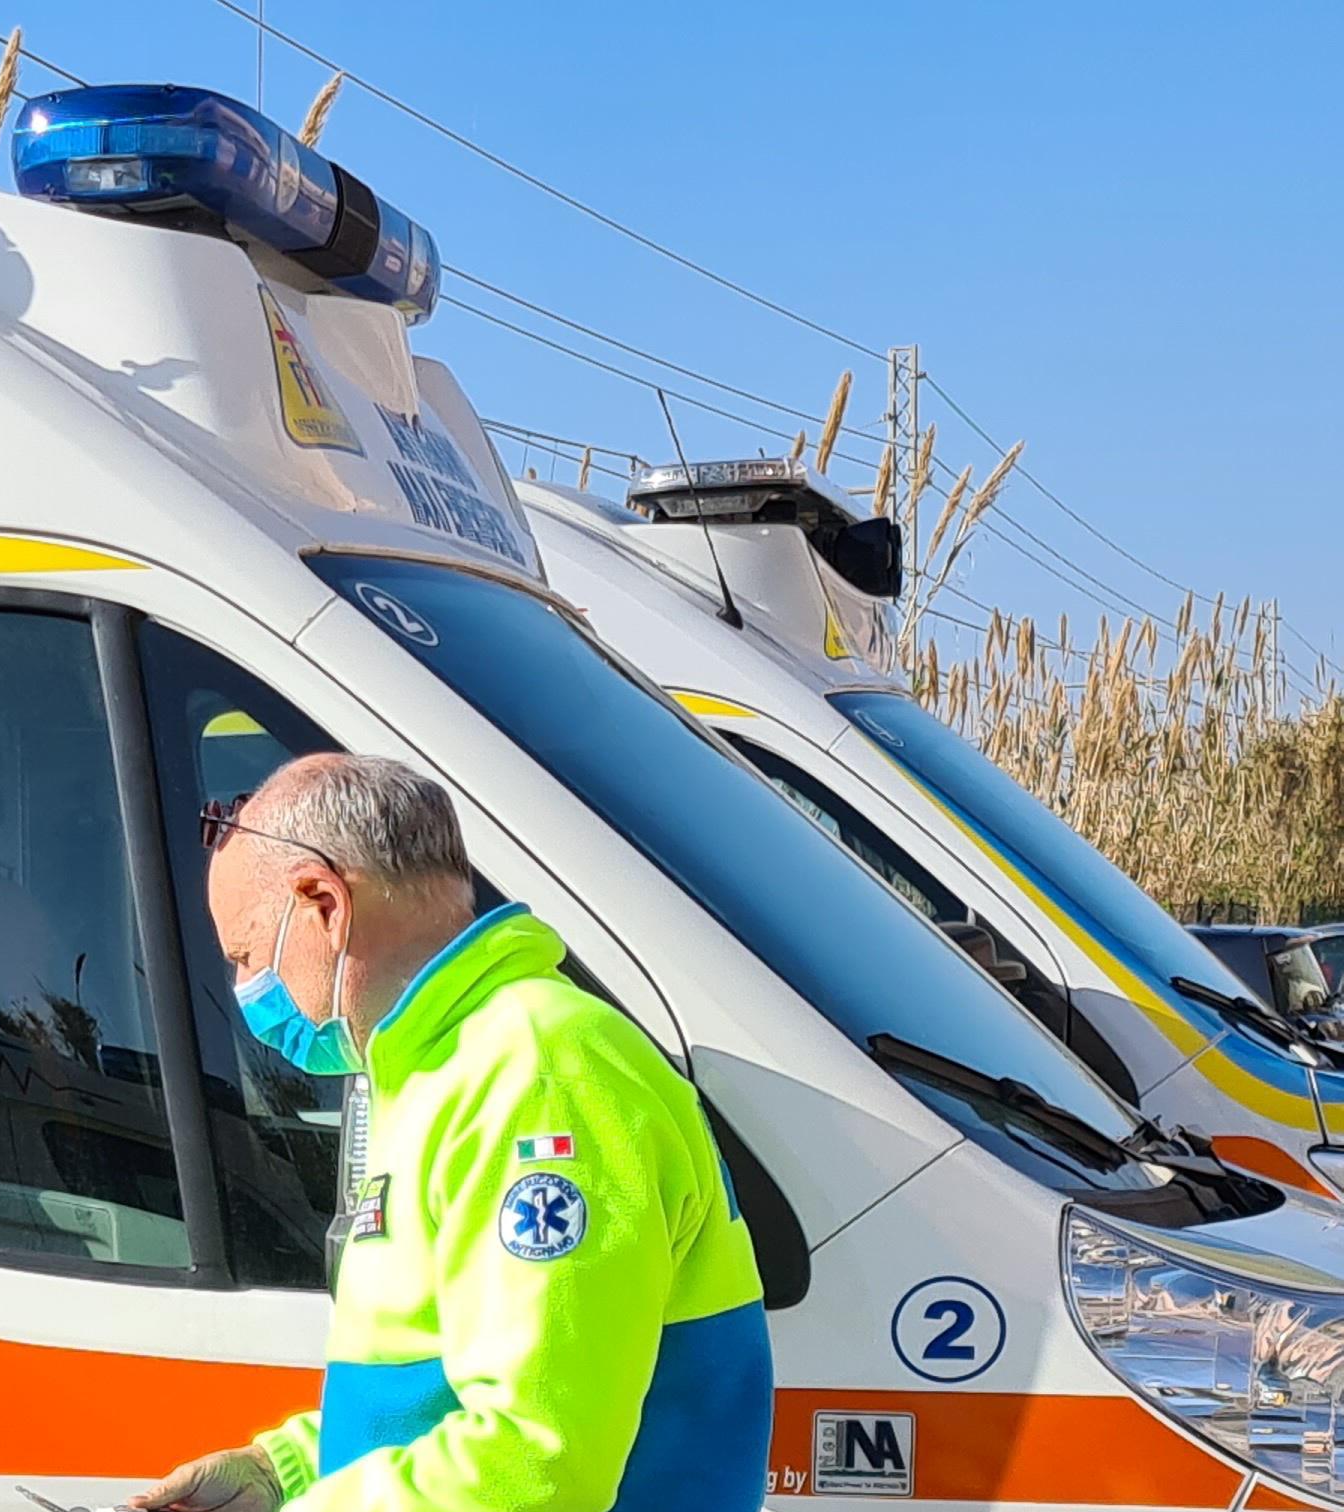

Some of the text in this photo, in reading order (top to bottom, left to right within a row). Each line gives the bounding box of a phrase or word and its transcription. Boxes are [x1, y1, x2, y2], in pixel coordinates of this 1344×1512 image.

[373, 596, 425, 634] 2
[922, 1300, 976, 1361] 2
[783, 1465, 808, 1494] by
